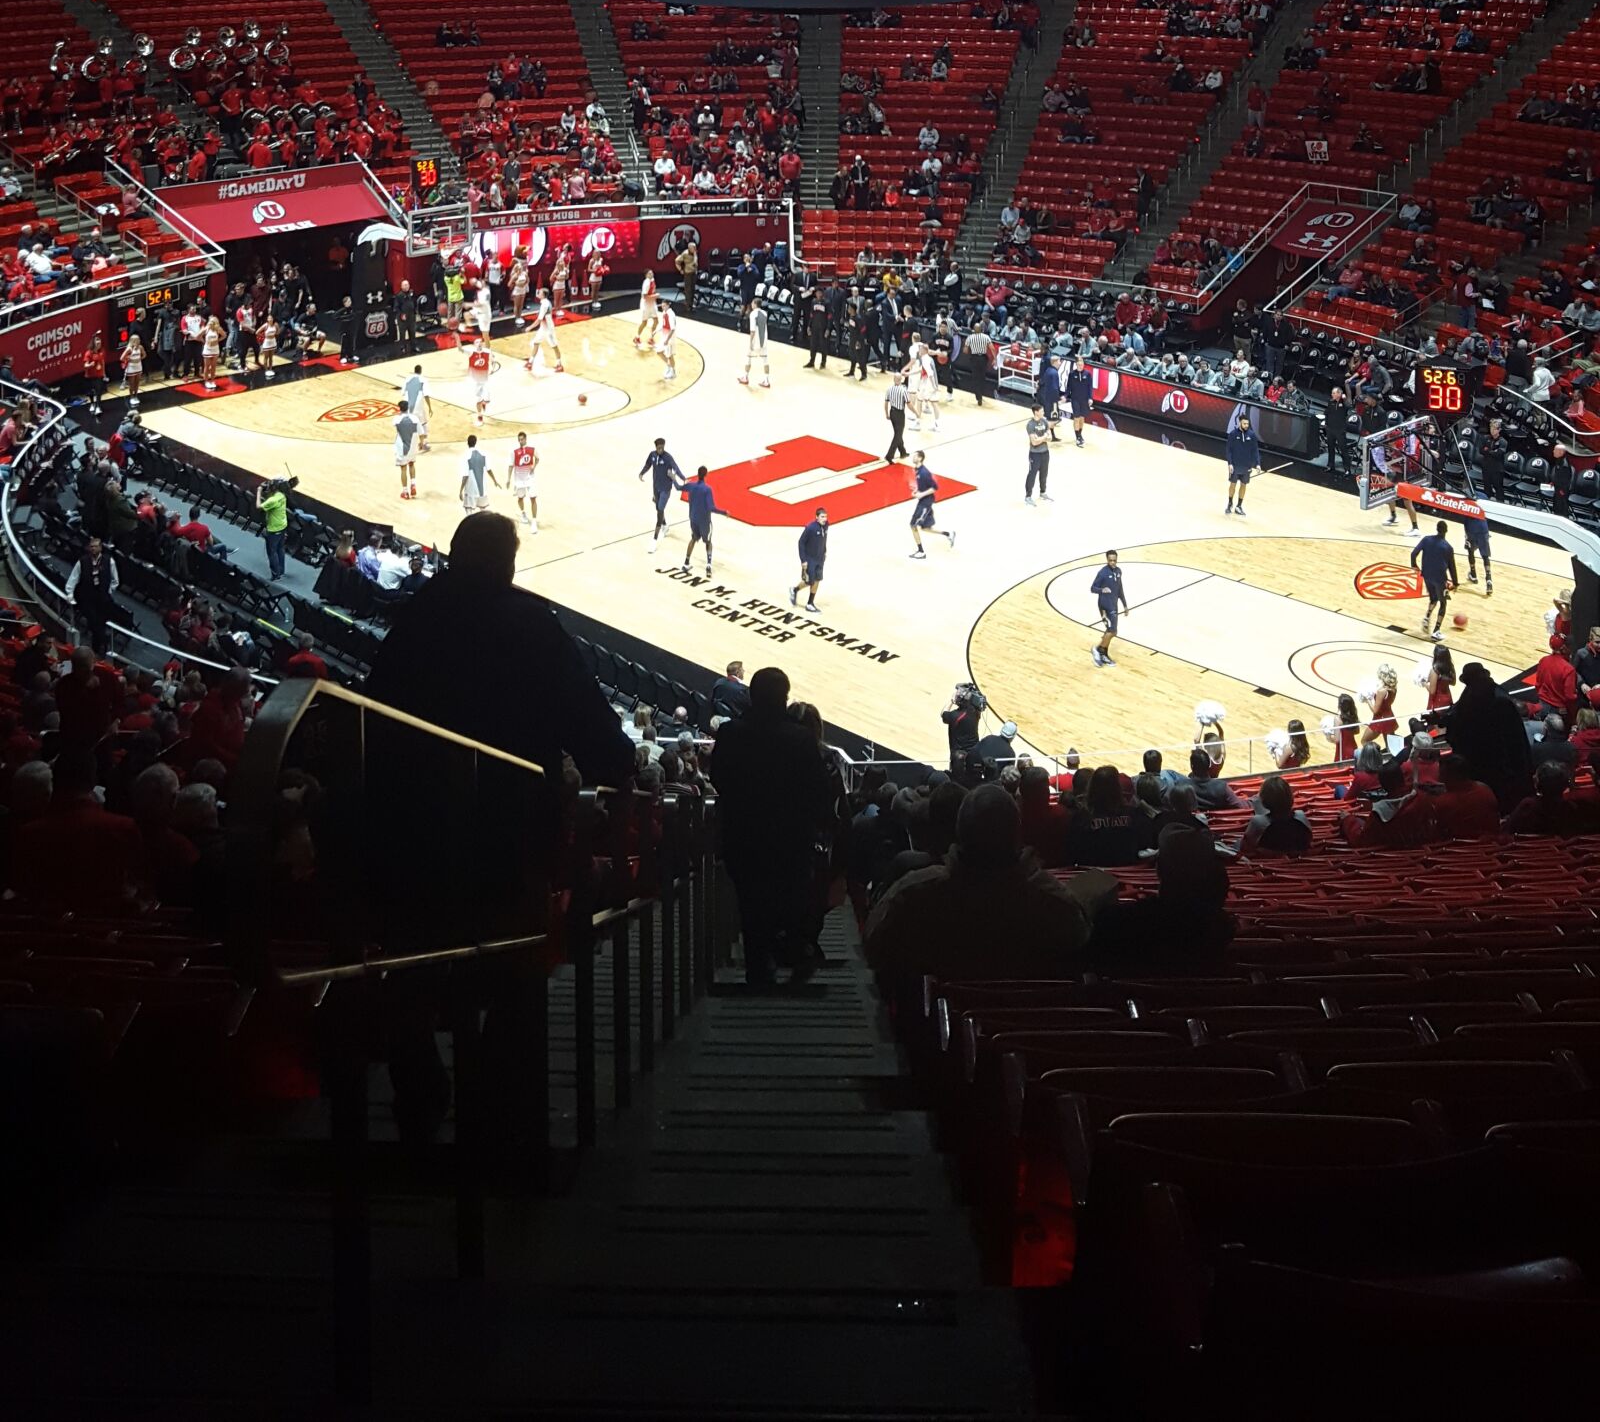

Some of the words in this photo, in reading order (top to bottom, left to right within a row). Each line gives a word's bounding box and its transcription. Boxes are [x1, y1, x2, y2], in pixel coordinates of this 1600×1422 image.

[420, 170, 437, 187] 30
[261, 204, 281, 217] U
[489, 217, 507, 226] WE
[510, 215, 529, 224] ARE
[531, 213, 550, 222] THE
[553, 211, 580, 220] MUSS
[259, 220, 317, 234] UTAH
[596, 232, 612, 248] U
[188, 278, 207, 289] GUEST
[117, 297, 135, 308] HOME
[370, 322, 384, 333] 66
[27, 321, 82, 351] CRIMSON
[38, 341, 70, 362] CLUB
[1424, 369, 1457, 385] 52.6
[1173, 394, 1185, 409] U
[1428, 385, 1462, 410] 30
[655, 566, 710, 588] JON
[705, 585, 736, 601] M.
[739, 598, 901, 664] HUNTSMAN
[691, 598, 796, 643] CENTER
